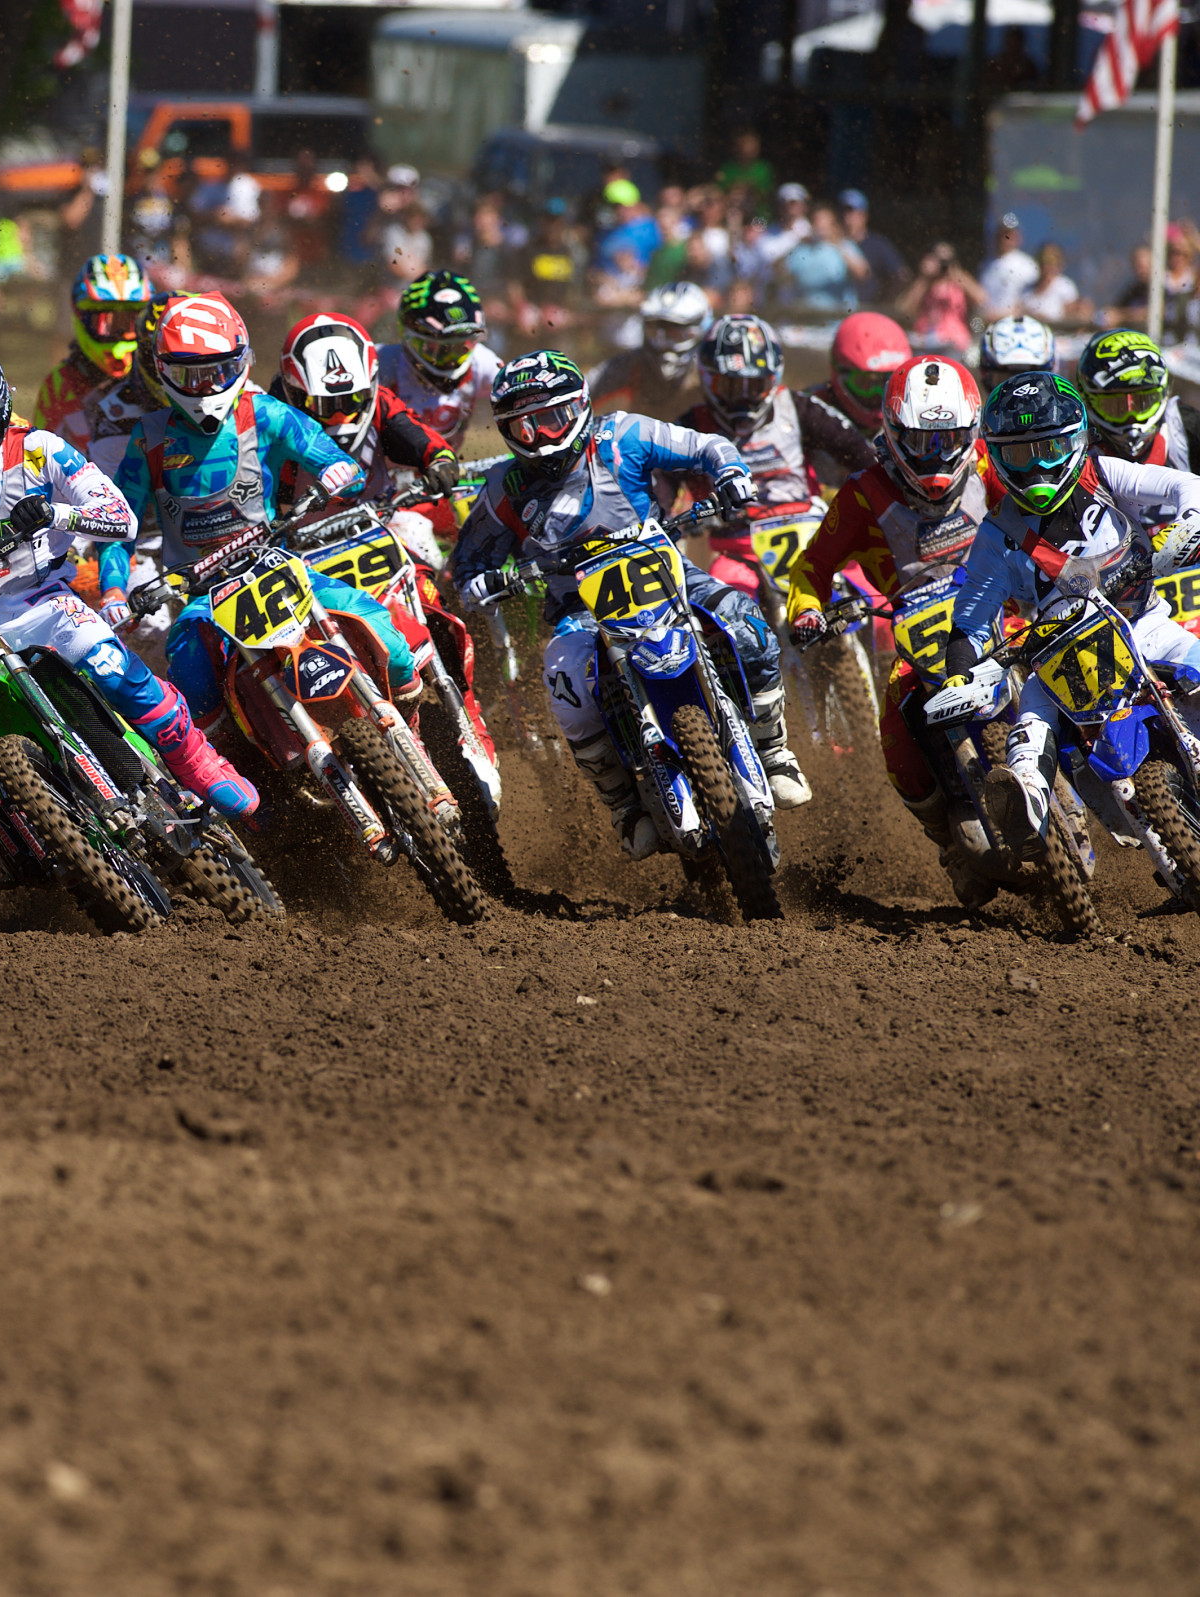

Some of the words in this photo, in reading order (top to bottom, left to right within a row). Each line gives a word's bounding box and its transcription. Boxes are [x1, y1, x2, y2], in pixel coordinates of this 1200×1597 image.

[1013, 384, 1040, 397] 6D
[920, 405, 954, 421] 6D
[523, 502, 536, 520] BELL
[80, 518, 128, 533] MONSTER
[184, 522, 247, 540] MOTOCROSS
[193, 526, 264, 574] RENTHAL
[921, 529, 977, 555] MOTOCROSS
[213, 579, 241, 606] KTM
[594, 550, 677, 622] 48
[235, 566, 302, 641] 42
[268, 624, 296, 643] GoPro
[1051, 621, 1117, 711] 17
[309, 668, 346, 697] KTM
[940, 701, 973, 719] UFO
[394, 732, 439, 789] DUNLOP
[727, 718, 764, 787] DUNLOP
[75, 754, 117, 800] BRAKING
